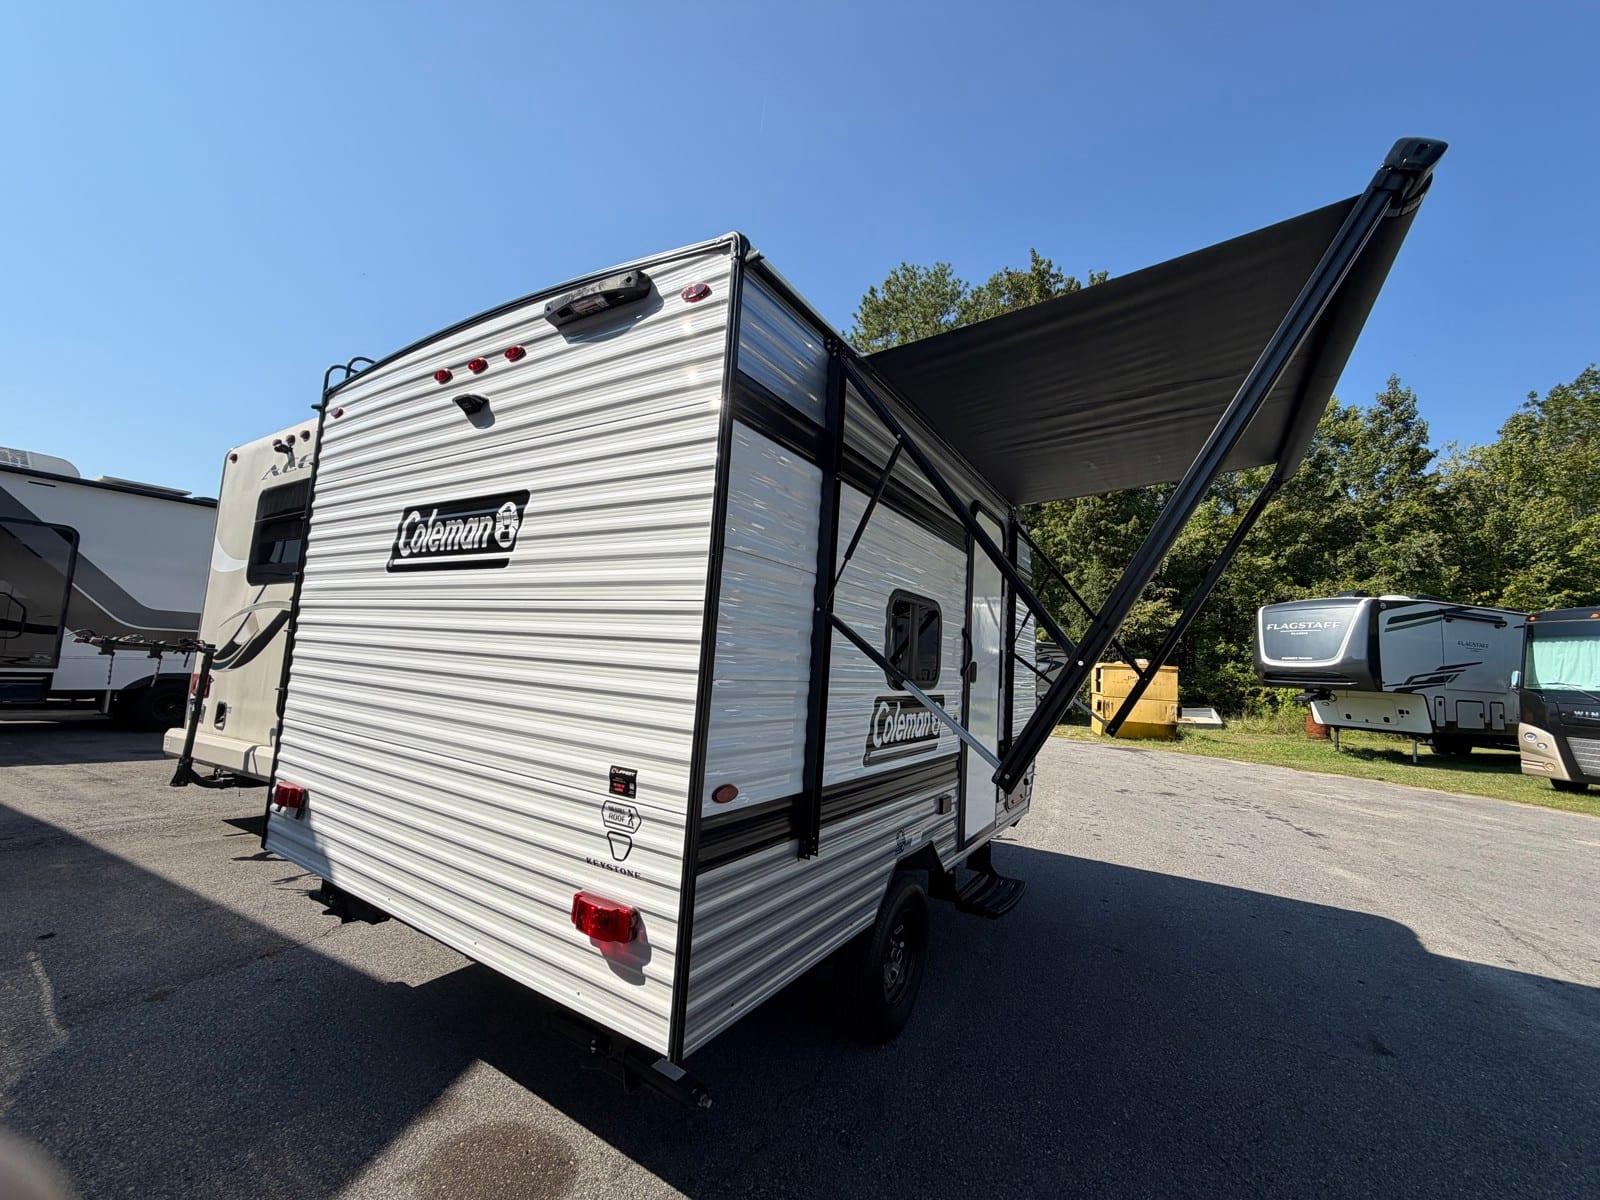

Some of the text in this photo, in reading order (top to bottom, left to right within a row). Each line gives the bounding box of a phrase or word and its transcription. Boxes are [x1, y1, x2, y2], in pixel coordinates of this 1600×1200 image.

[398, 508, 494, 557] Coleman
[1266, 621, 1342, 631] FLAGSTAFF
[872, 700, 931, 748] Coleman
[586, 857, 641, 880] KEYSTONE
